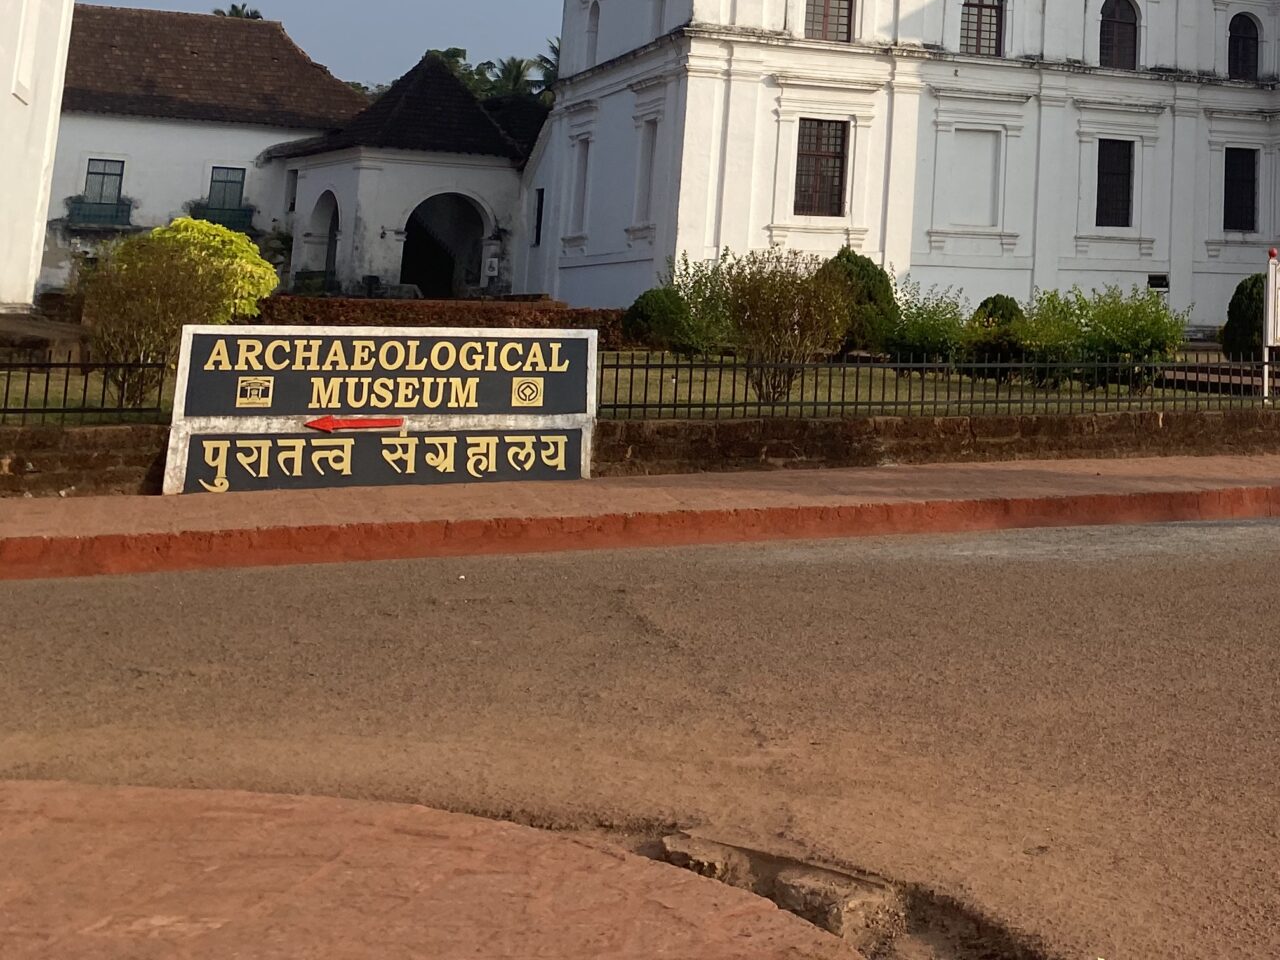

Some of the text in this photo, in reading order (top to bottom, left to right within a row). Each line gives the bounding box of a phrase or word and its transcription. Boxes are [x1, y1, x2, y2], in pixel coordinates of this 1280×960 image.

[203, 339, 570, 372] ARCHAEOLOGICAL
[308, 377, 479, 409] MUSEUM
[198, 431, 568, 493] पुरातत्व संग्रहालय
